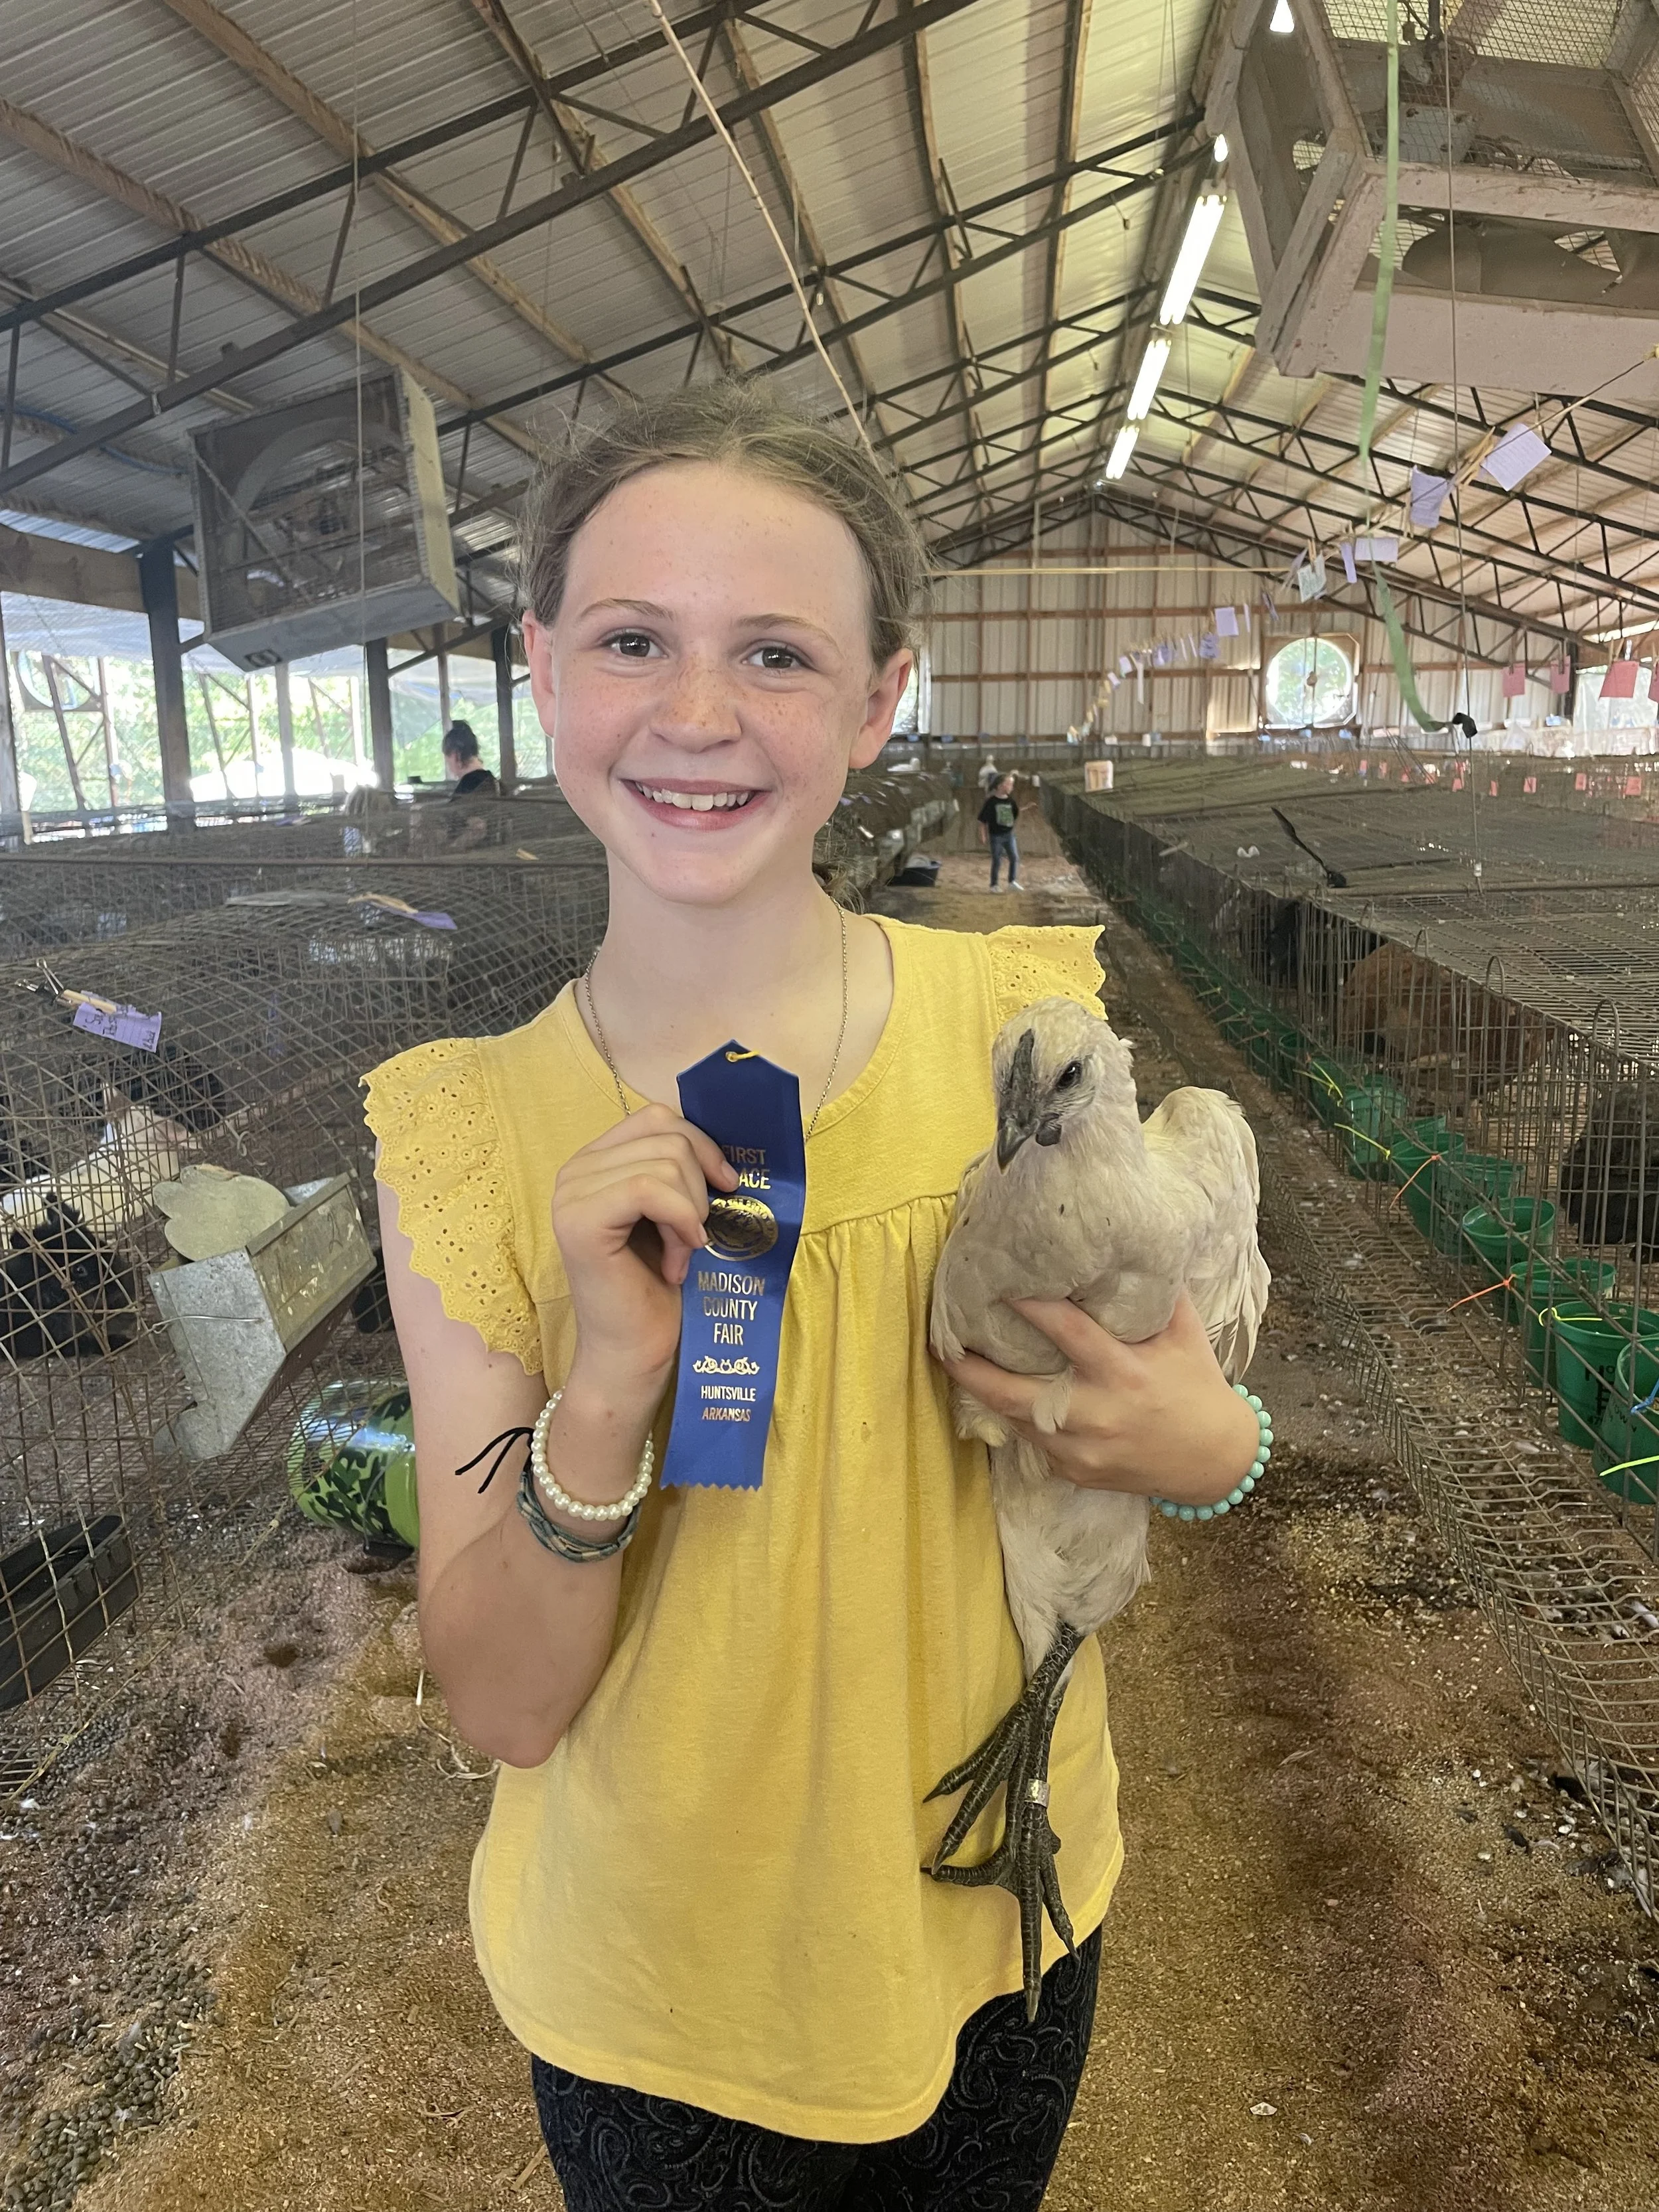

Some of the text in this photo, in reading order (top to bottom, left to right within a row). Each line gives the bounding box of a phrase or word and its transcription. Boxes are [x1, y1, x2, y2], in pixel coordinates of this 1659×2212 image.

[721, 1144, 766, 1165] FIRST
[739, 1166, 772, 1190] ACE
[697, 1270, 765, 1296] MADISON
[703, 1296, 758, 1321] COUNTY
[713, 1323, 744, 1346] FAIR
[701, 1385, 757, 1402] HUNTSVILLE
[702, 1407, 751, 1422] ARKANSAS
